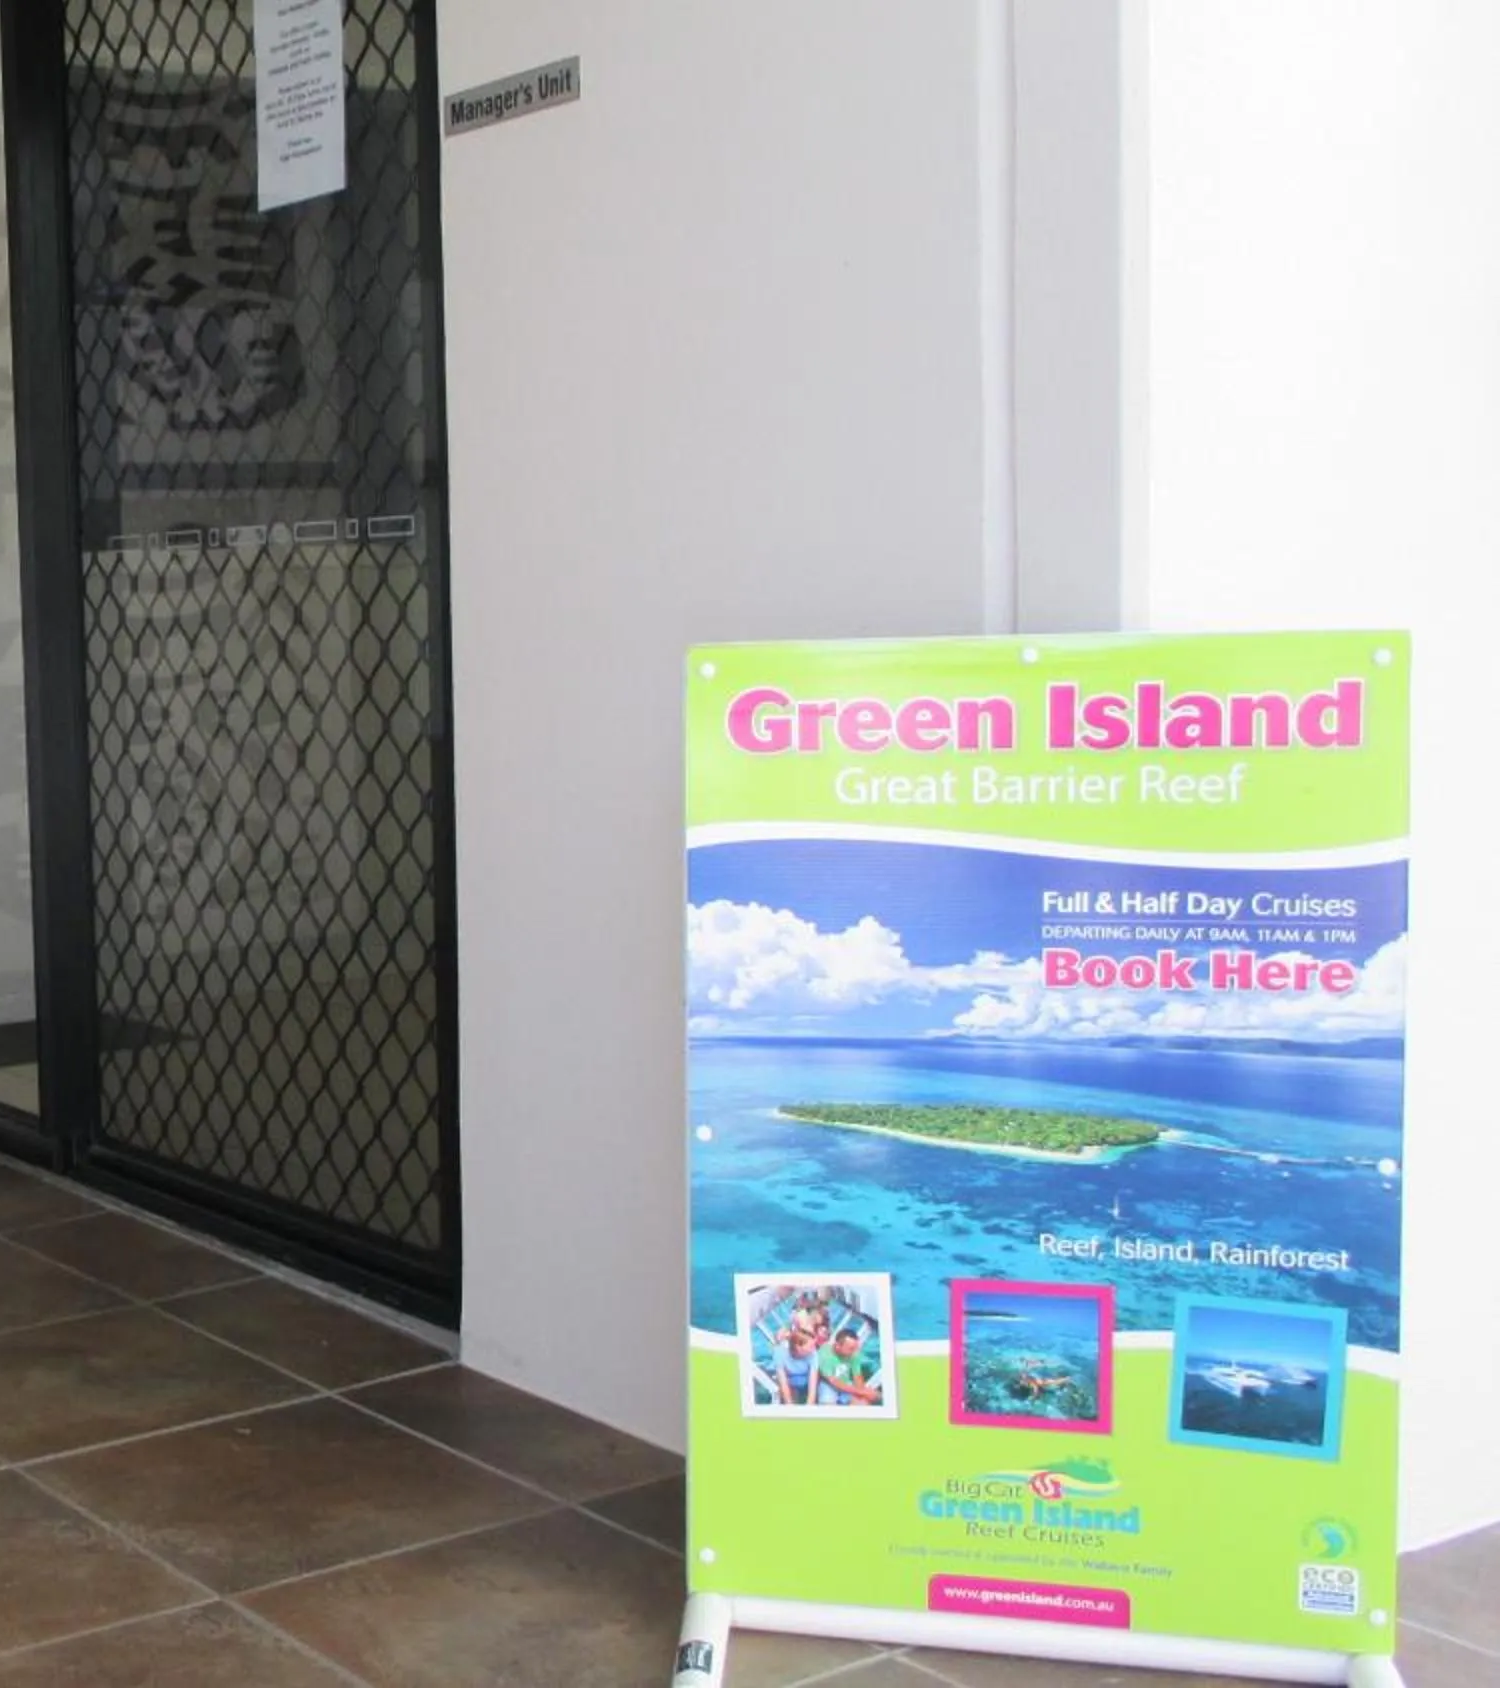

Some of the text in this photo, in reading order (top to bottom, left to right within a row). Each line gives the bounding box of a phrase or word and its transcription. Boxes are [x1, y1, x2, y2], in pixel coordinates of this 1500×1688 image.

[451, 68, 573, 126] Manager's Unit
[726, 678, 1366, 754] Green Island
[835, 762, 1248, 805] Great Barrier Reef
[1043, 891, 1357, 921] Full & Half Day Cruises
[1041, 925, 1131, 940] DEPARTING
[1135, 927, 1182, 942] DAILY
[1184, 927, 1204, 941] AT
[1257, 929, 1299, 943] 11AM
[1303, 930, 1316, 943] &
[1323, 930, 1356, 944] 1PM
[1042, 948, 1357, 995] Book Here
[1039, 1233, 1350, 1271] Reef, Island, Rainforest
[946, 1479, 1022, 1499] Big Cat
[918, 1489, 1142, 1535] Green Island
[965, 1522, 1106, 1549] Reef Cruises
[943, 1584, 1116, 1613] www.greenisland.com.au
